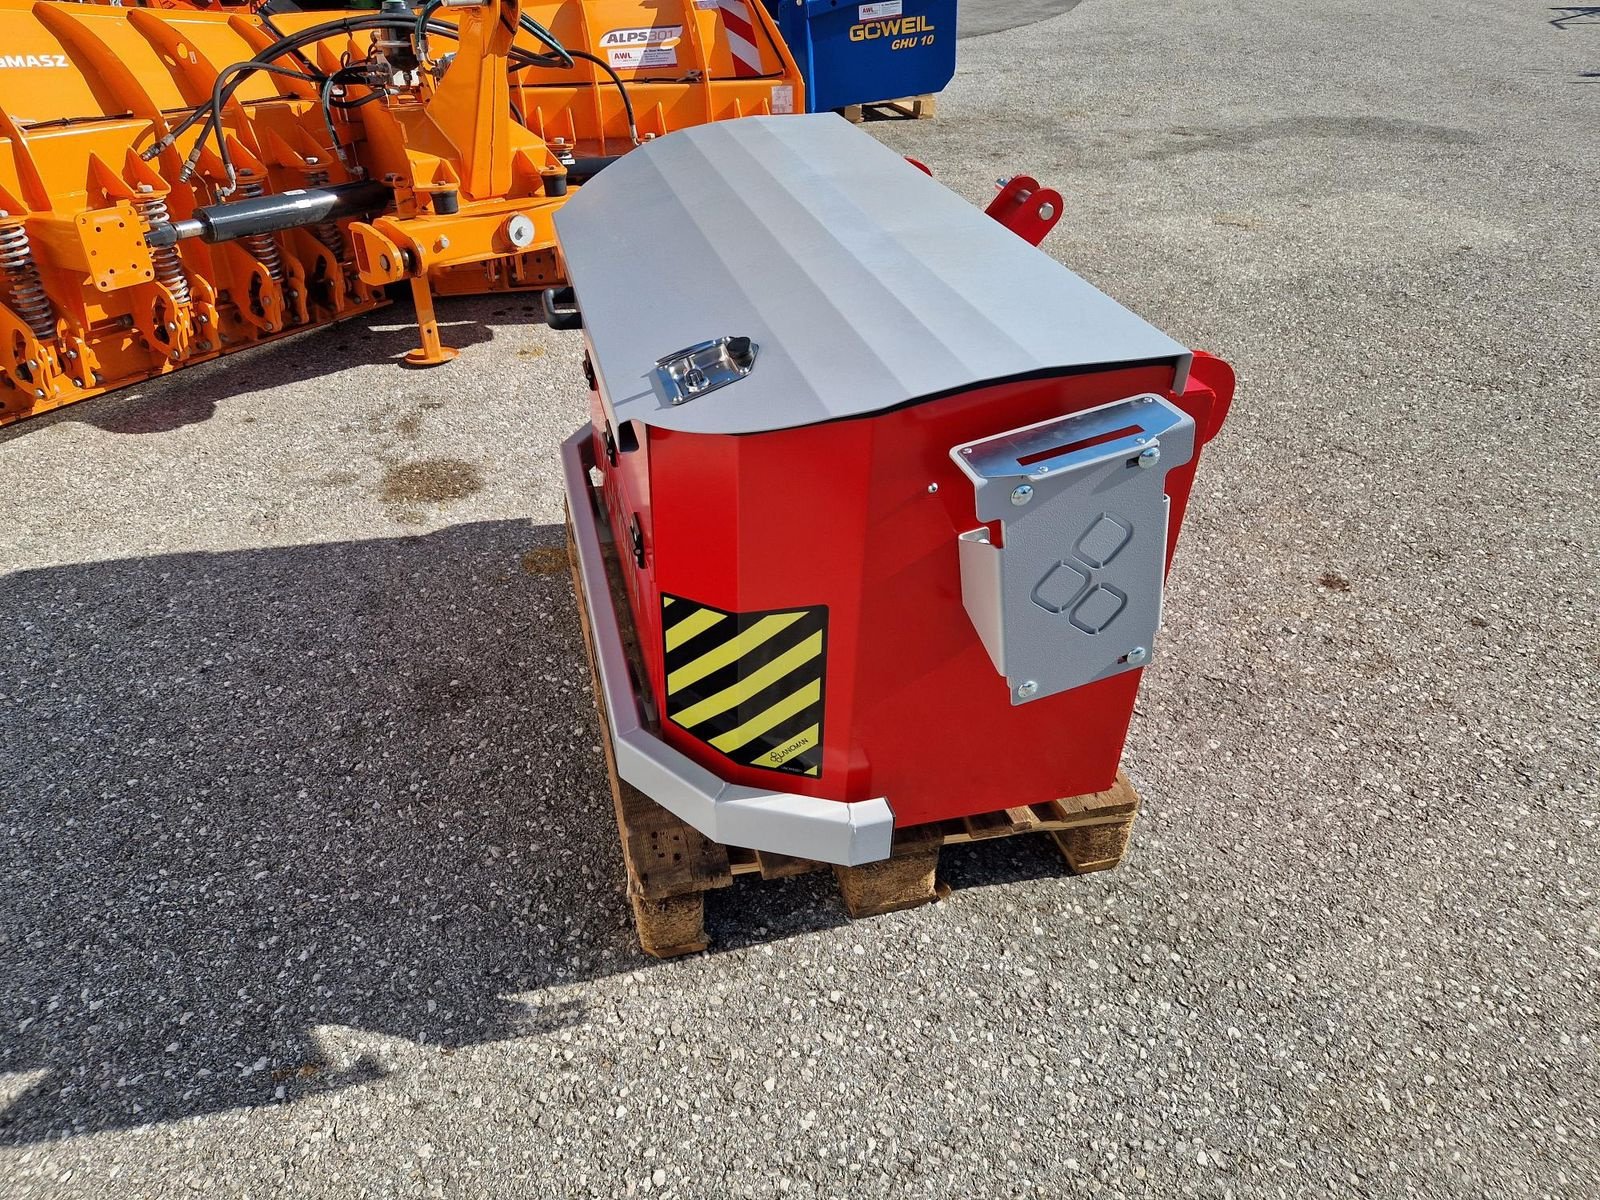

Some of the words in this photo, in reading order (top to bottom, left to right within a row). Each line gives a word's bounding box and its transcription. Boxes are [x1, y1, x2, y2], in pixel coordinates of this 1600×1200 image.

[891, 37, 918, 50] GHU
[921, 34, 935, 46] 10
[614, 52, 632, 60] AWL
